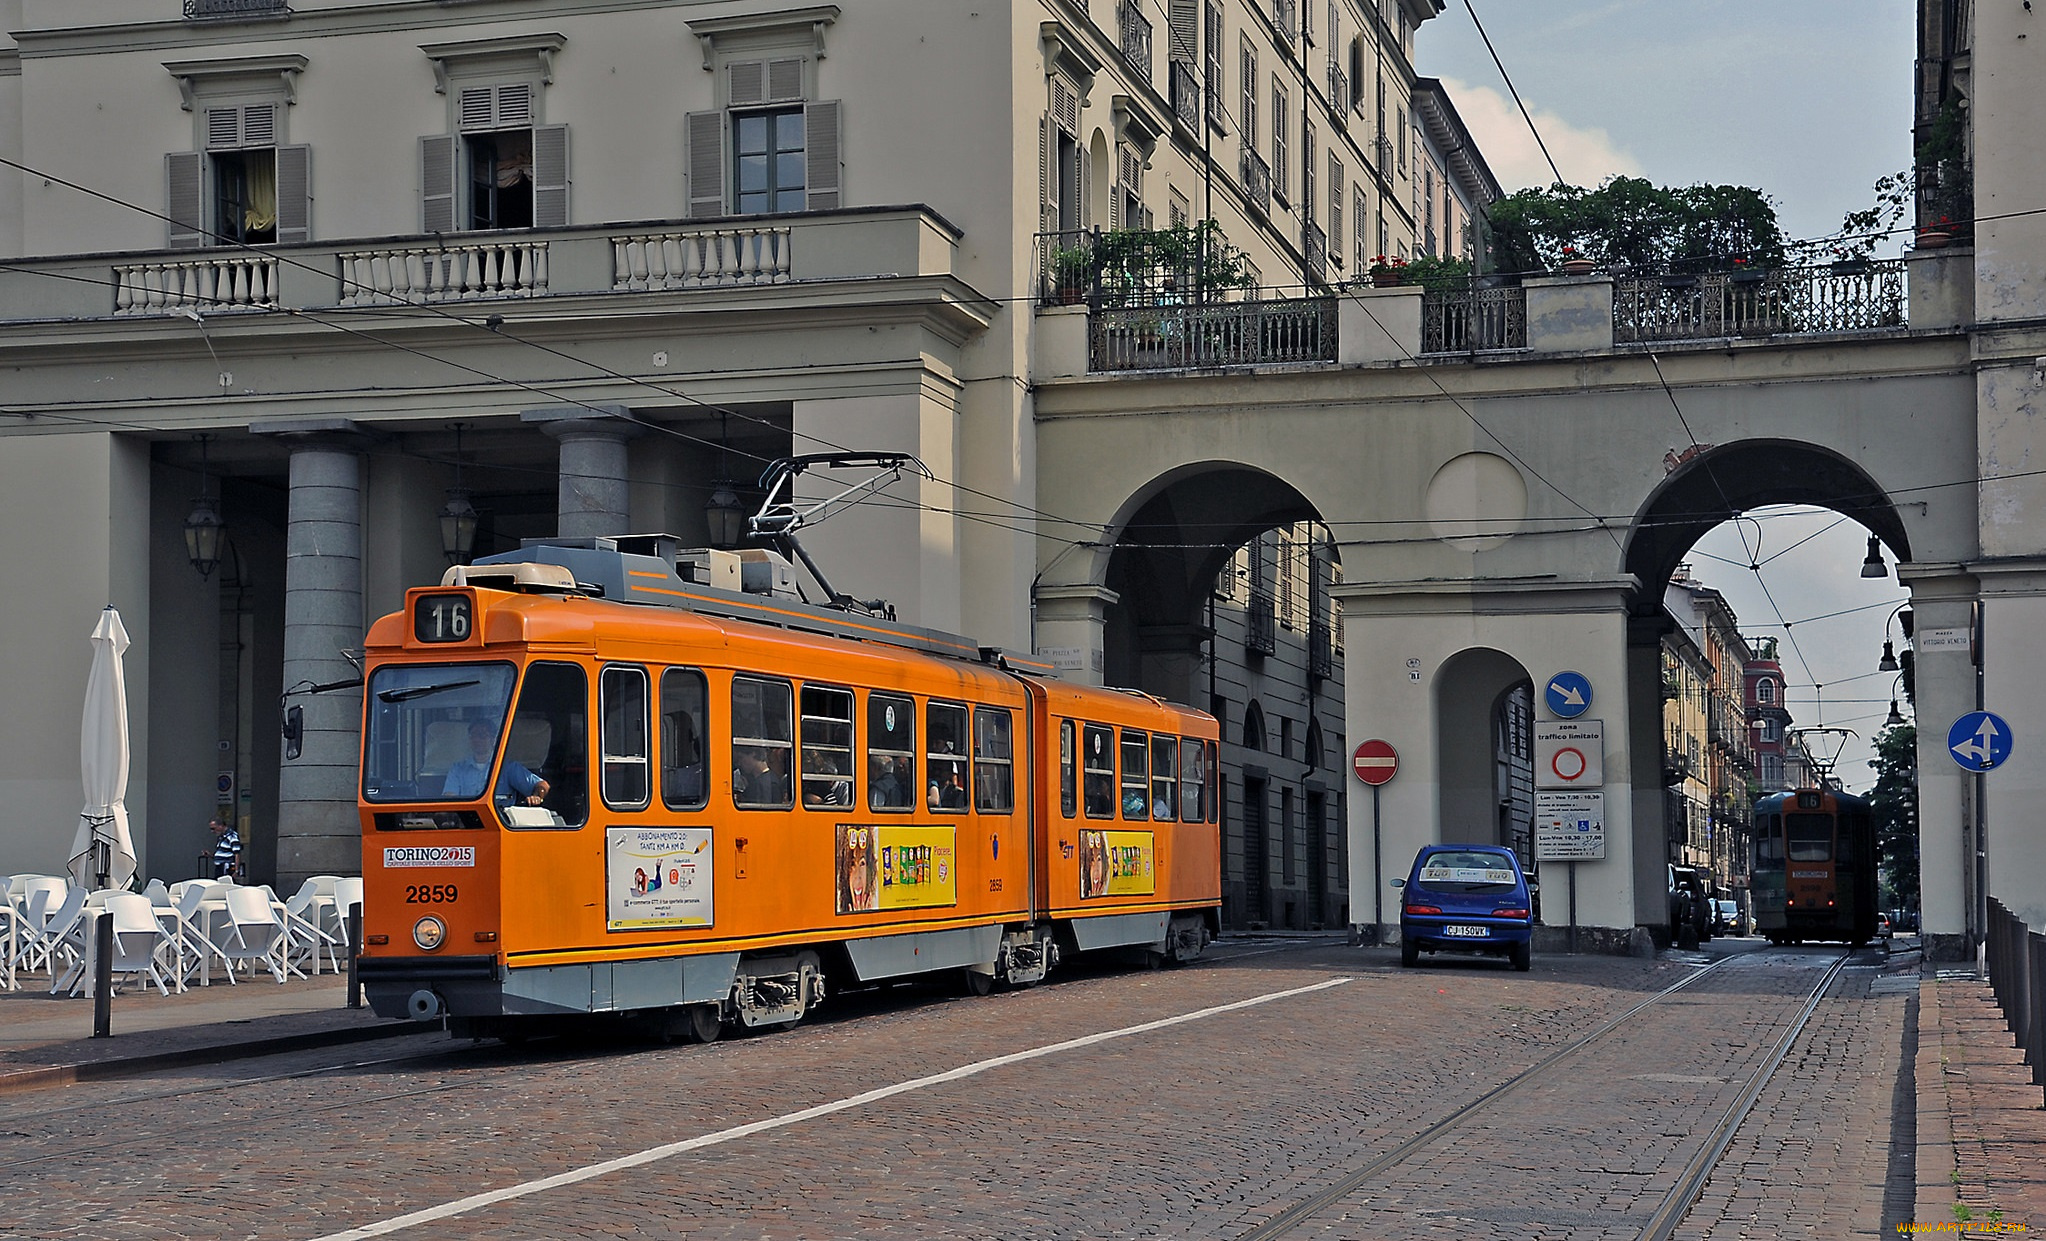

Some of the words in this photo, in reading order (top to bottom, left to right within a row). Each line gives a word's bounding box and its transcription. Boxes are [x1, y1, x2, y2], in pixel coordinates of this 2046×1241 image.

[432, 602, 467, 638] 16
[637, 832, 677, 841] ABBONAMENTO
[640, 843, 656, 851] TANTI
[989, 879, 1002, 892] 2859
[405, 884, 458, 904] 2859
[1447, 926, 1458, 934] CJ
